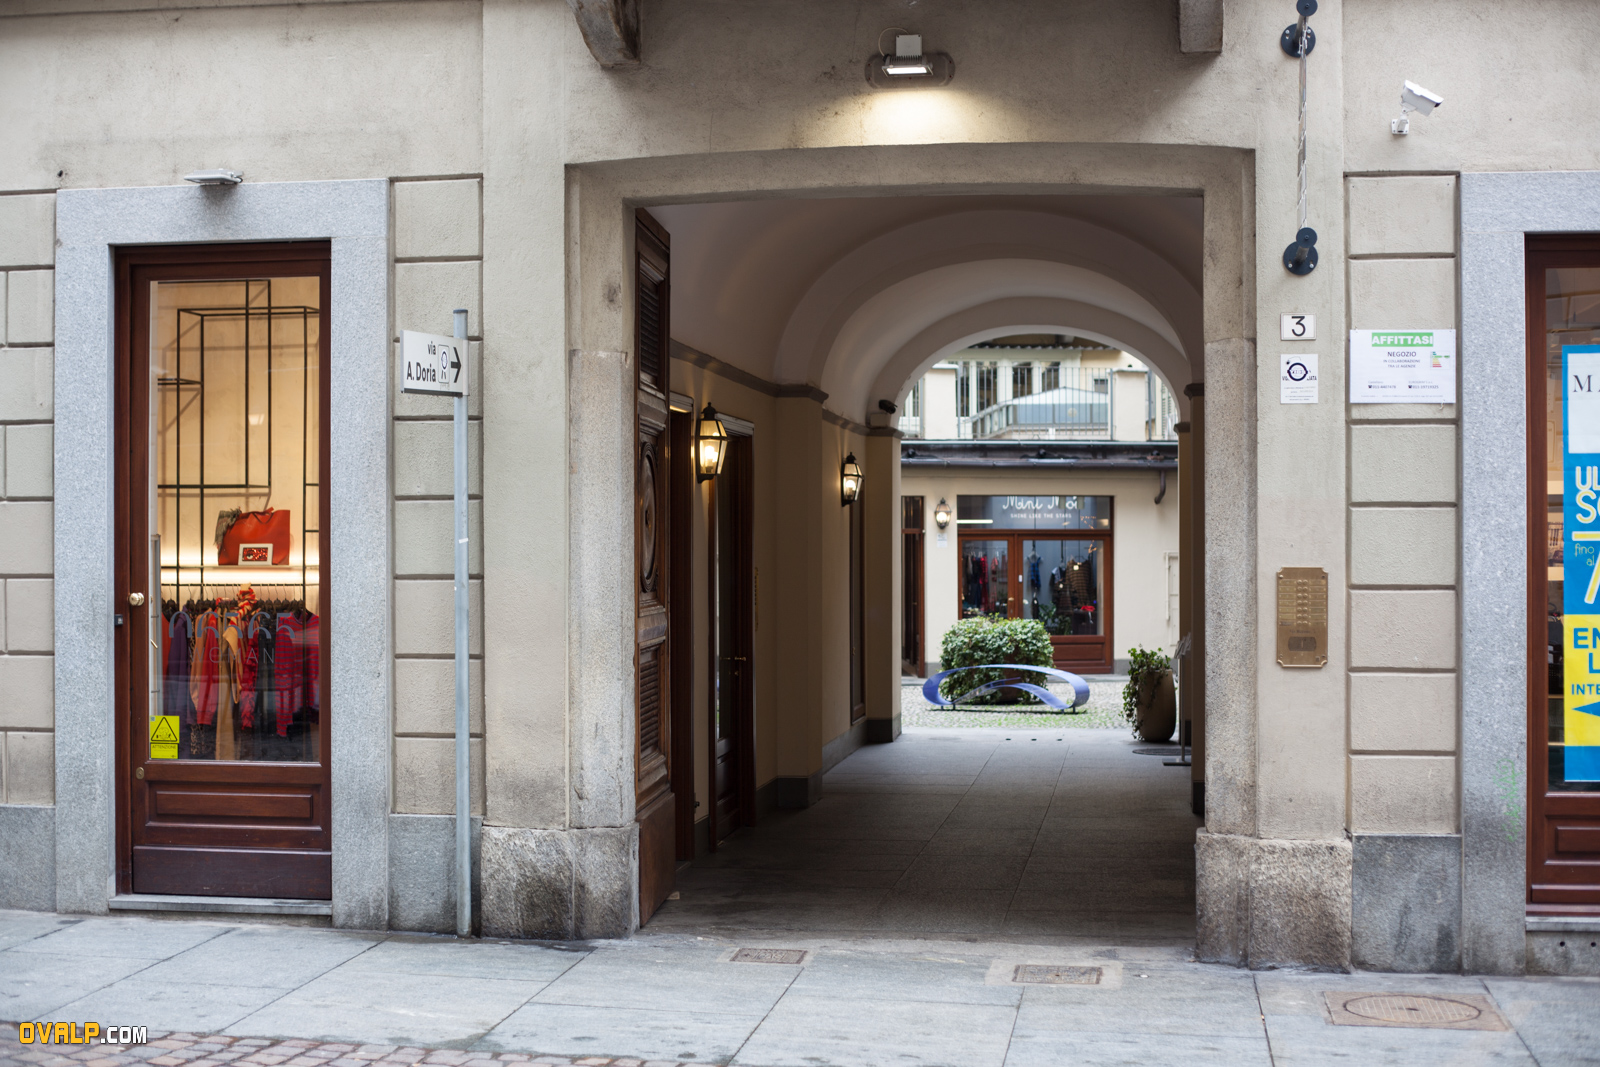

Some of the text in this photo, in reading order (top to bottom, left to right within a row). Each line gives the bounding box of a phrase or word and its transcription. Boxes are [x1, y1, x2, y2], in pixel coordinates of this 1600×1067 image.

[1291, 315, 1306, 337] 3
[427, 340, 436, 355] via
[1371, 335, 1434, 345] AFFITTASI
[406, 361, 437, 382] A. Doria
[1572, 374, 1600, 393] M
[1575, 465, 1600, 490] UL
[1002, 495, 1043, 510] Mini
[1575, 489, 1600, 524] S
[1574, 542, 1595, 557] fino
[1586, 554, 1595, 566] al
[188, 646, 275, 663] WOMAN
